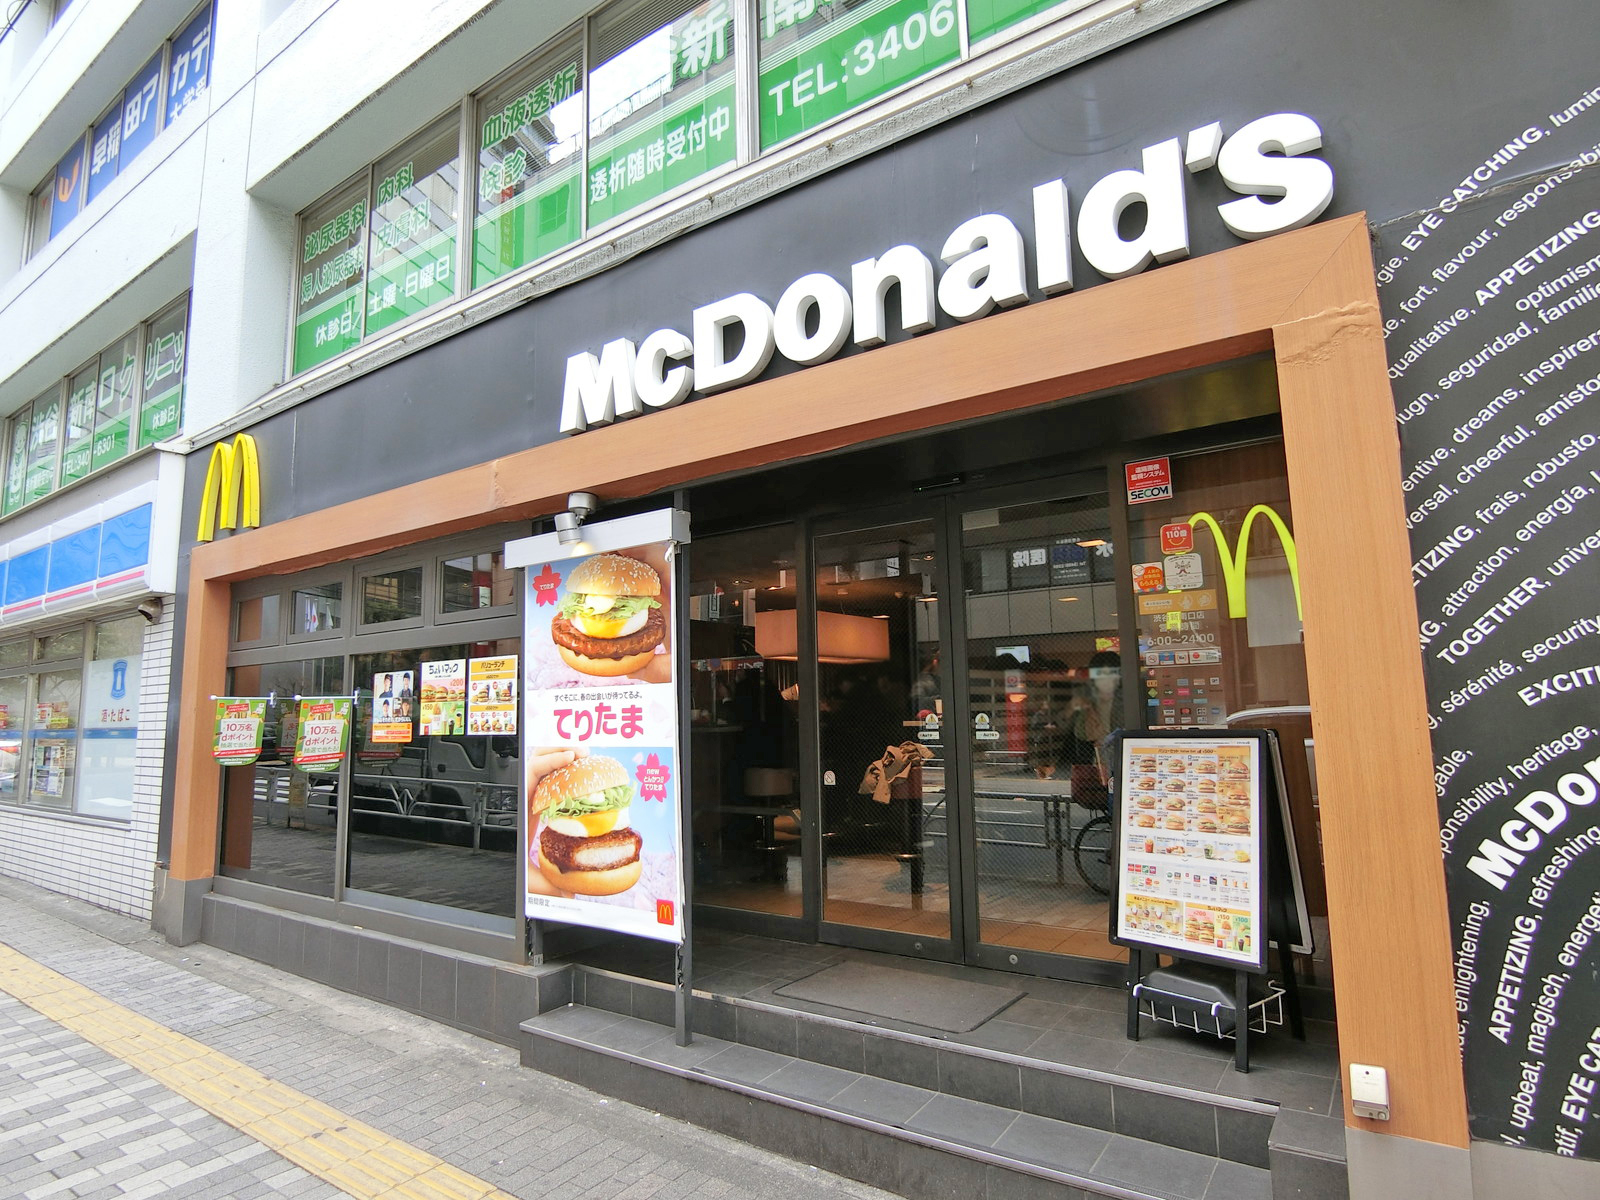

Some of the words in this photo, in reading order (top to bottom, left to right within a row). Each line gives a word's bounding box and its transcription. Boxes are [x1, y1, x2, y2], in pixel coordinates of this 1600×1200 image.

[768, 1, 955, 118] TEL:3406
[481, 63, 577, 150] 血液透析
[376, 162, 414, 207] 内科
[480, 149, 527, 201] 検診
[590, 106, 730, 205] 透析随時受付中
[304, 198, 367, 264] 泌尿器科
[374, 198, 432, 258] 皮膚科
[1376, 256, 1409, 288] gie,
[1401, 213, 1444, 252] EYE
[1438, 126, 1551, 214] CATCHING,
[559, 112, 1335, 434] McDonald's
[1387, 308, 1477, 380] qualitative,
[1474, 211, 1600, 307] APPETIZING
[1399, 284, 1438, 315] fort,
[1431, 228, 1499, 283] flavour,
[1437, 321, 1539, 391] seguridad,
[1452, 387, 1526, 443] dreams,
[1519, 328, 1600, 386] inspirer
[1456, 424, 1537, 485] cheerful,
[1534, 372, 1600, 427] amisto
[1130, 484, 1170, 501] SECOM
[1475, 489, 1527, 525] frais,
[1441, 545, 1520, 617] attraction,
[1515, 486, 1596, 542] energia,
[1436, 576, 1552, 665] TOGETHER,
[429, 663, 459, 675] ちょいマック
[1440, 659, 1523, 713] sérénité,
[221, 733, 254, 742] dポイント
[304, 736, 339, 747] dポイント
[553, 702, 644, 742] てりたま
[1506, 725, 1599, 780] heritage,
[1440, 776, 1515, 860] ponsibility,
[1453, 900, 1491, 1013] enlightening,
[1487, 913, 1543, 1045] APPETIZING,
[1527, 973, 1571, 1055] magisch,
[1510, 1060, 1546, 1129] upbeat,
[1560, 1072, 1596, 1123] EYE
